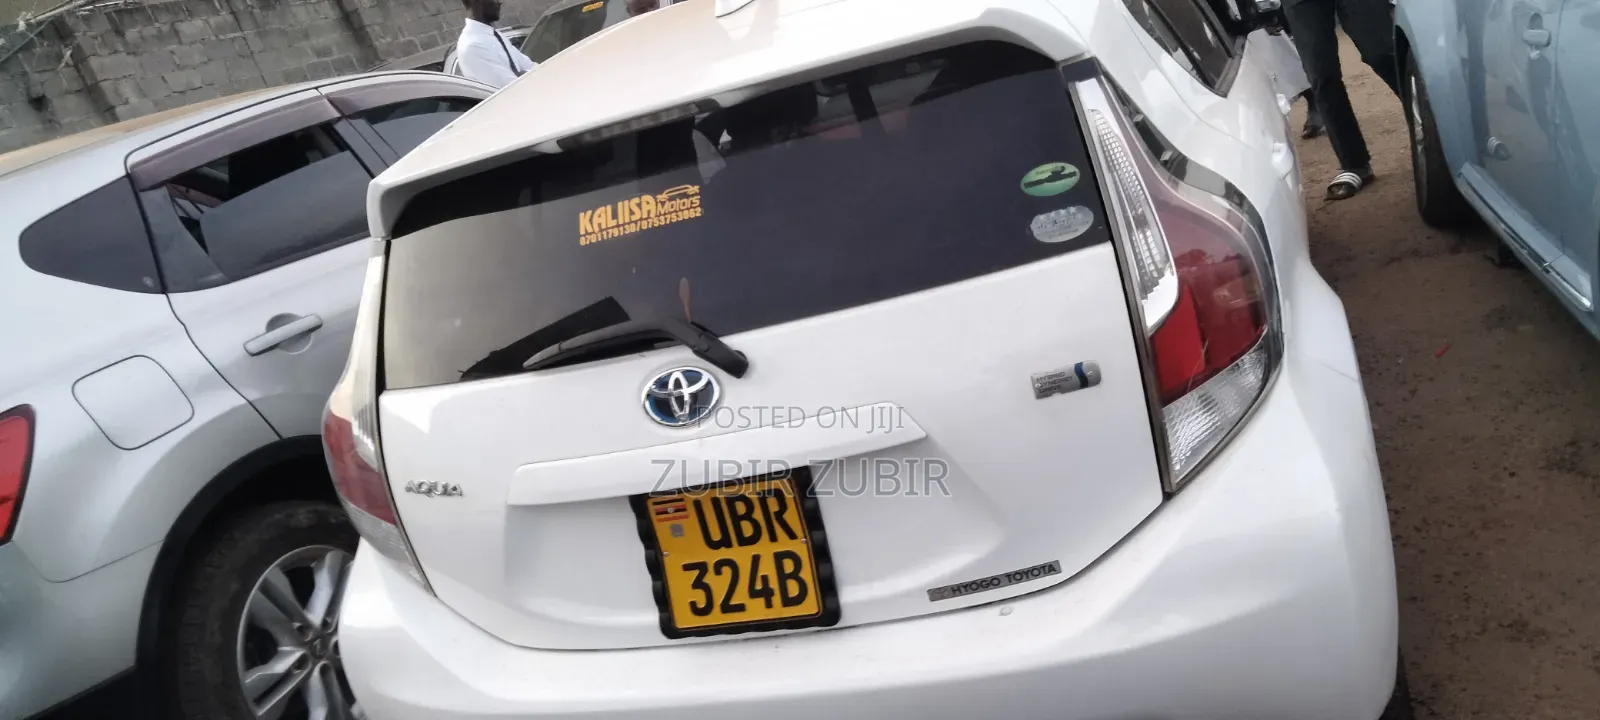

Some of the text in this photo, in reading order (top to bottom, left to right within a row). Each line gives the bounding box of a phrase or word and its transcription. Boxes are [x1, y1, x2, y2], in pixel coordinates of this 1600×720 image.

[579, 194, 700, 235] KALIISA Motors
[404, 479, 464, 498] AQUA
[692, 488, 798, 550] UBR
[681, 550, 808, 617] 324B
[951, 562, 1058, 595] HYOGO TOYOTA
